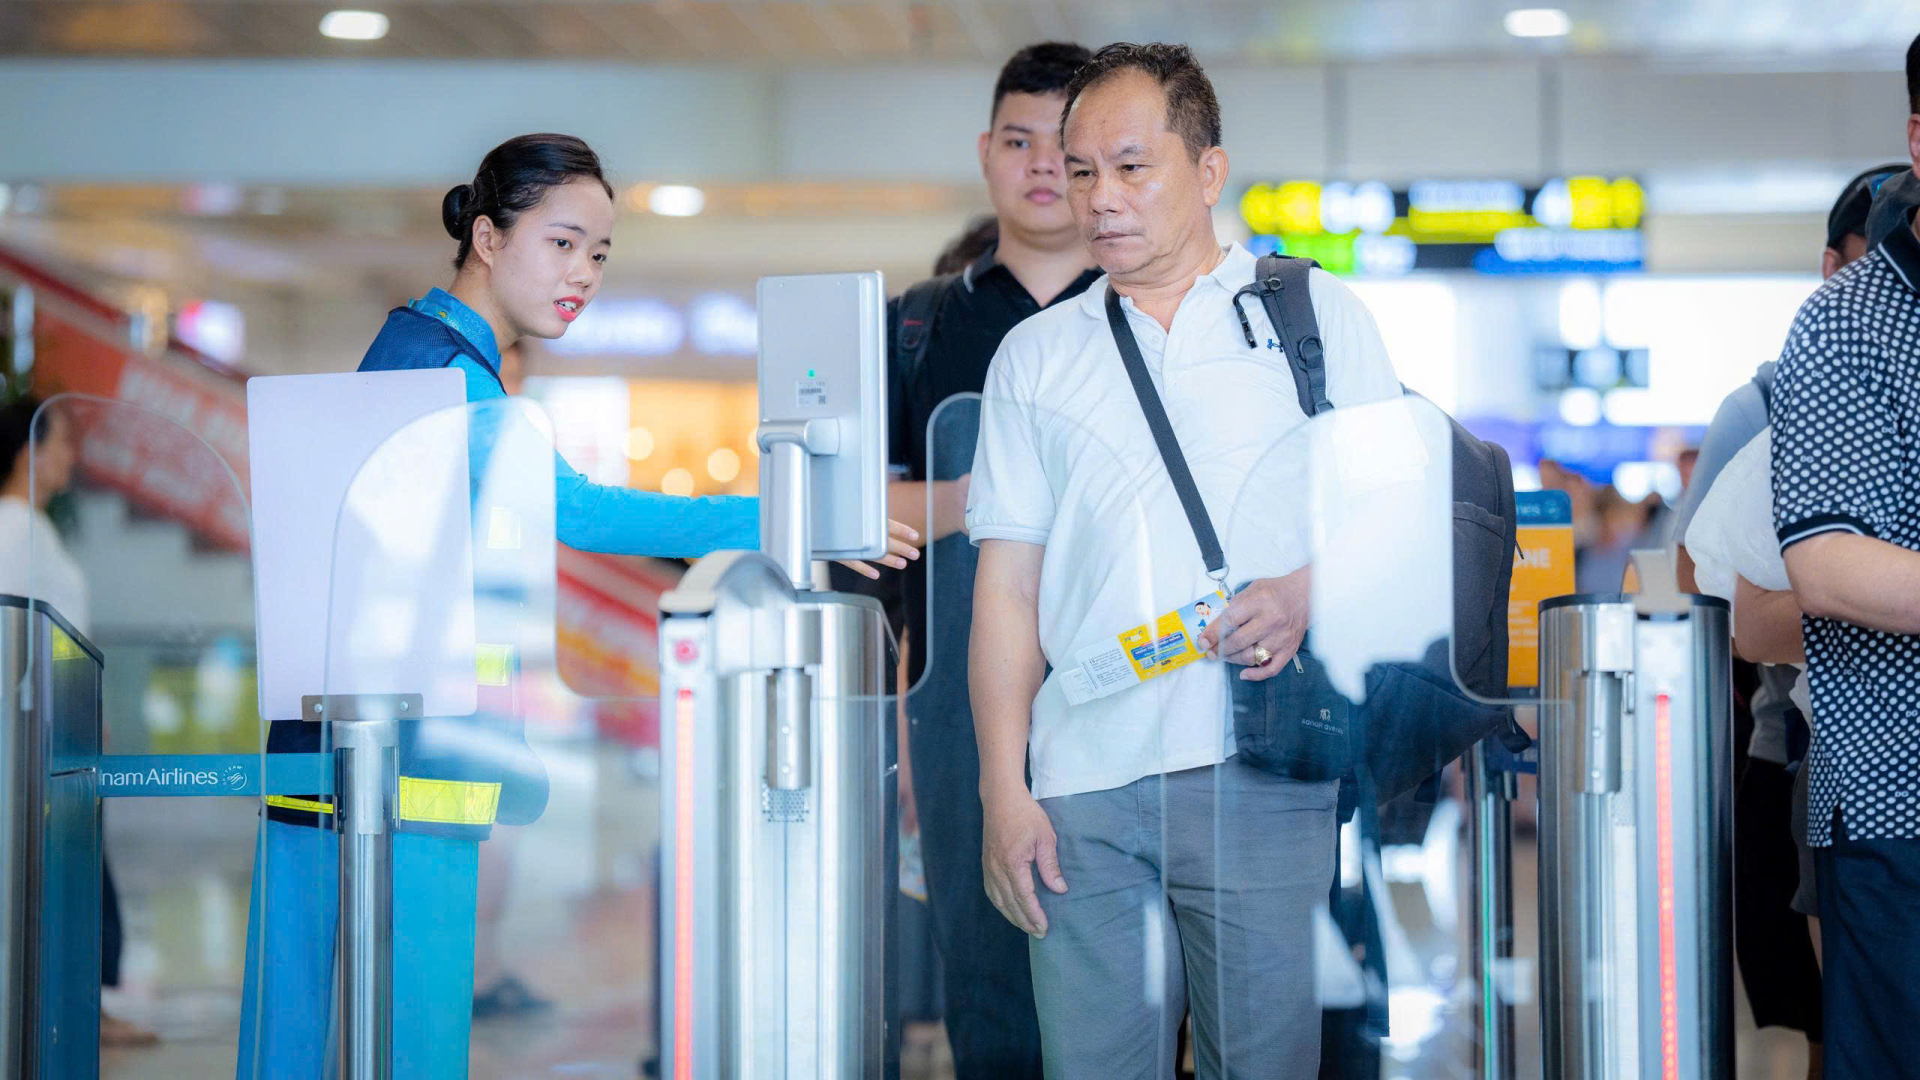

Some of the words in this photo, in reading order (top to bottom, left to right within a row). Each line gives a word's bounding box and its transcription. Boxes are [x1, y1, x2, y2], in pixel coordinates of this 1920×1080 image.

[1881, 426, 1896, 435] DG
[1800, 455, 1814, 463] DG
[1905, 709, 1918, 718] DG
[145, 767, 219, 786] Airlines
